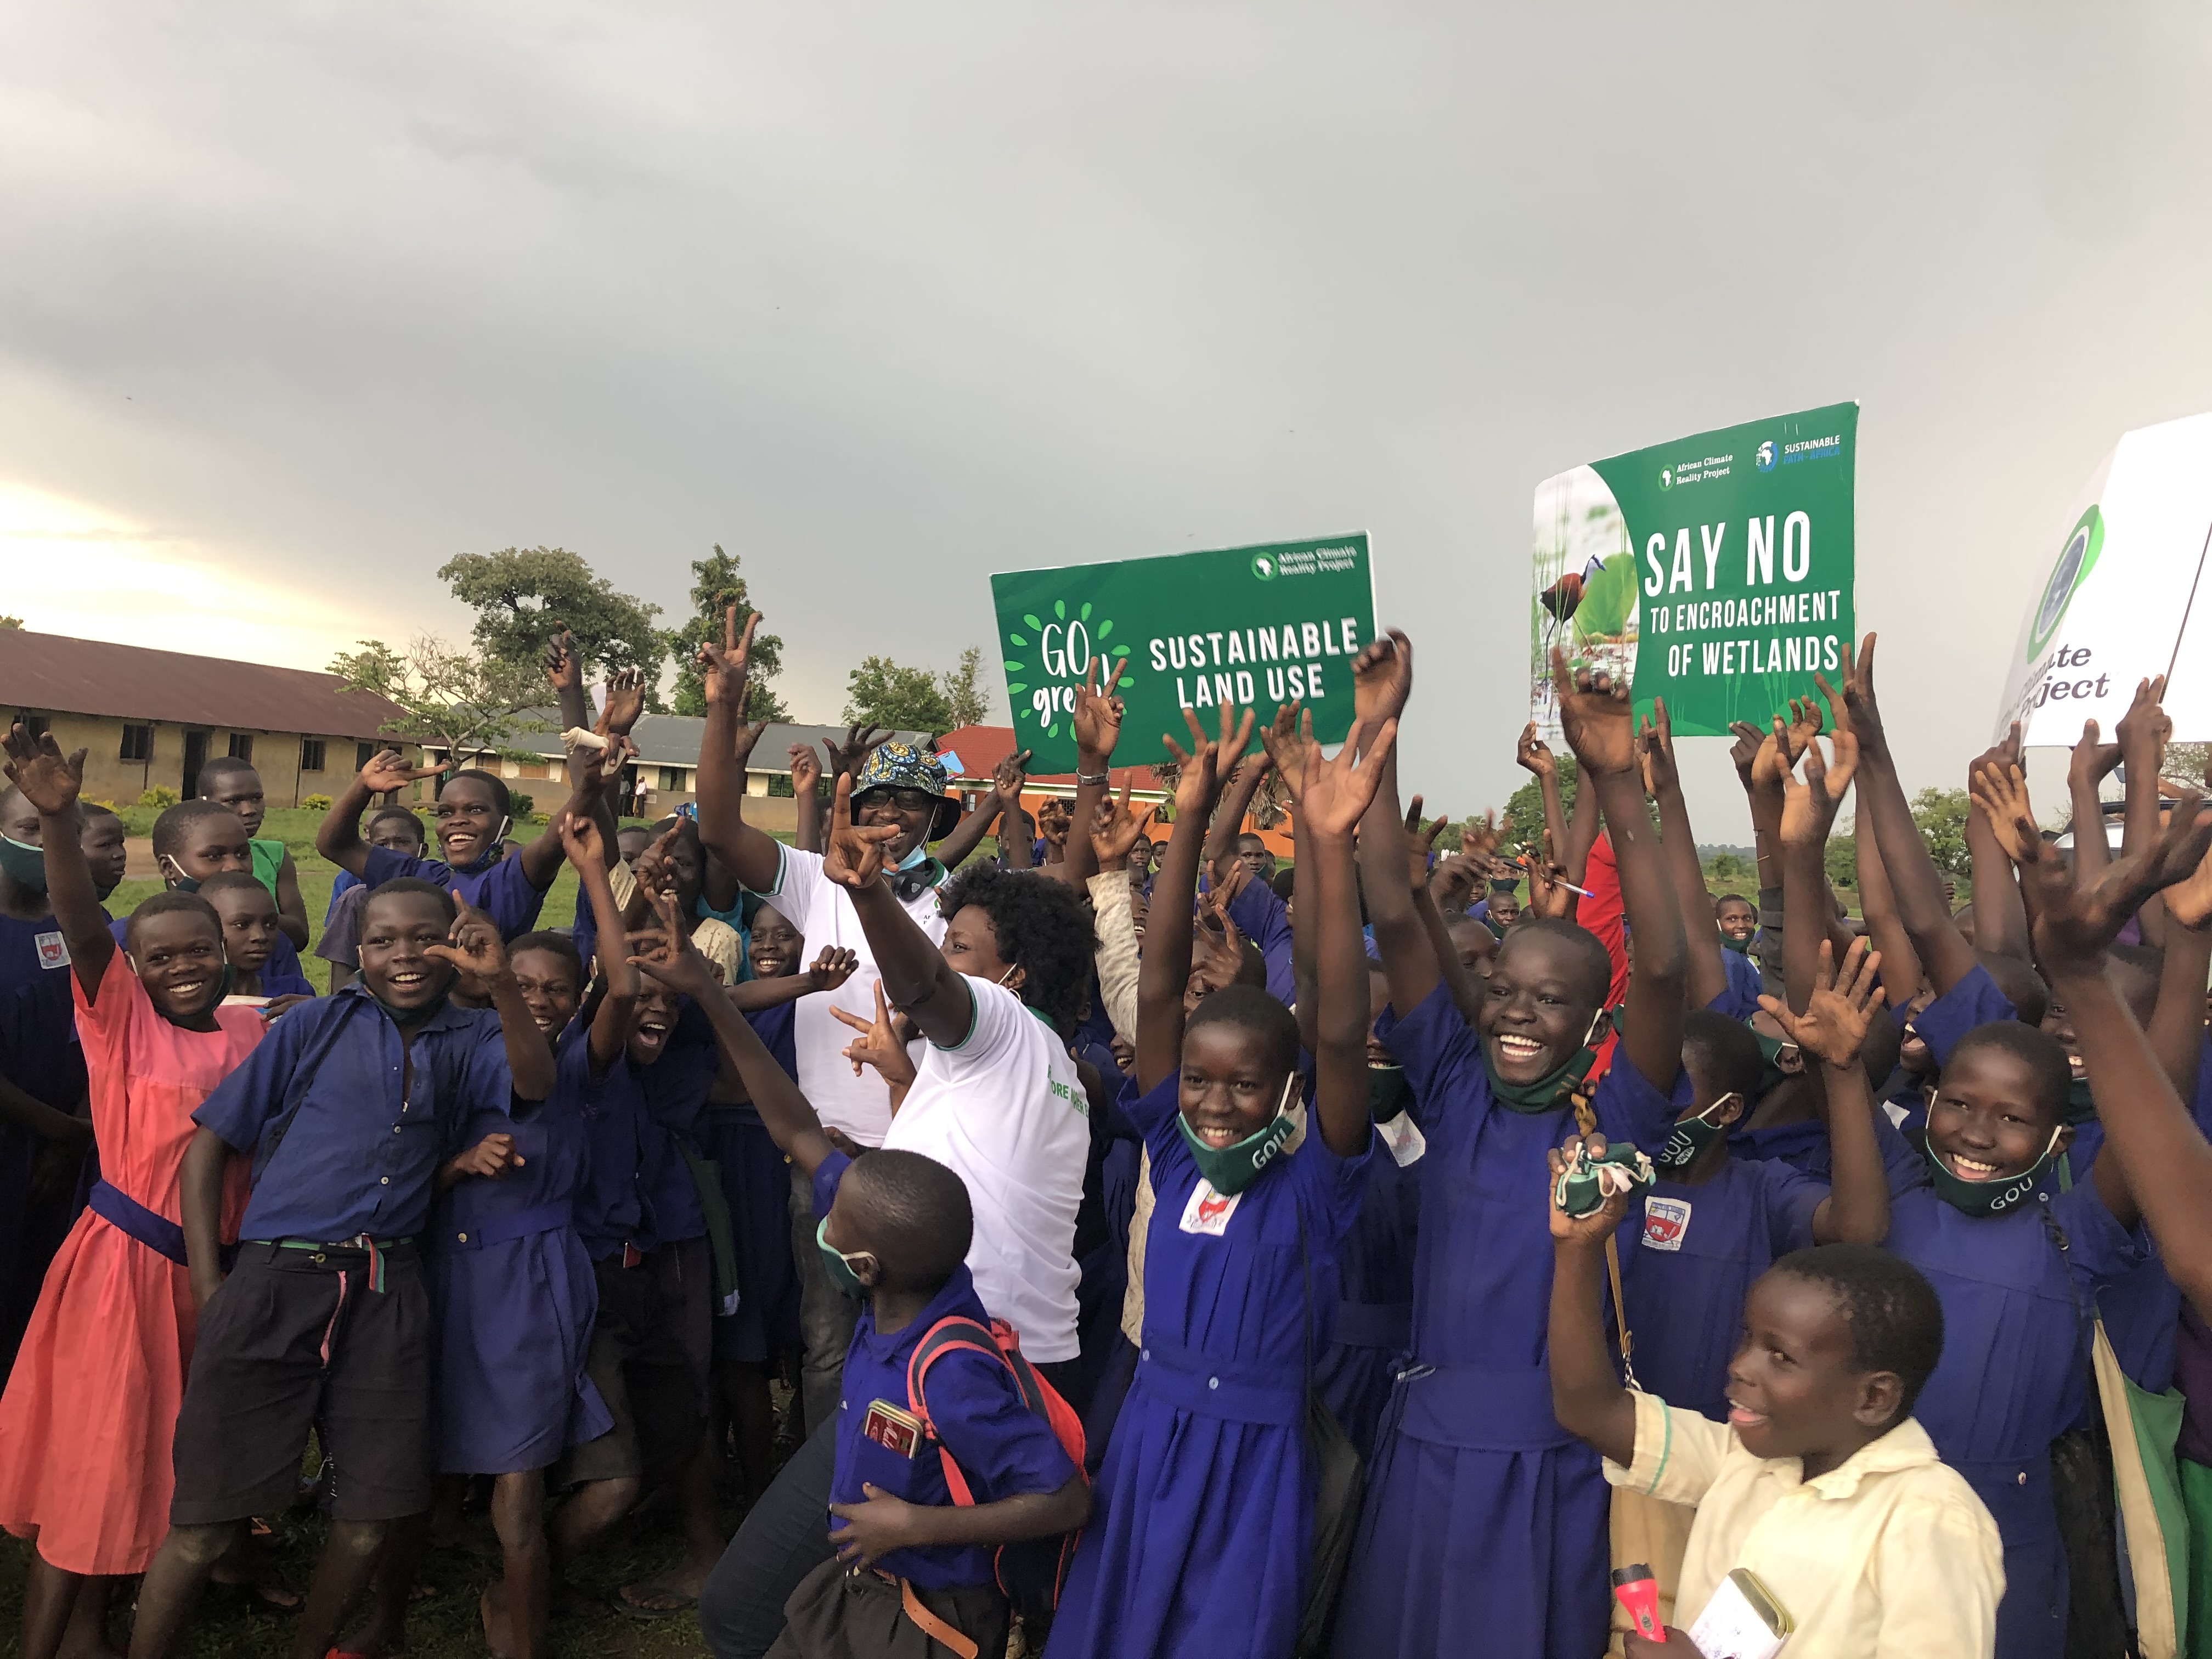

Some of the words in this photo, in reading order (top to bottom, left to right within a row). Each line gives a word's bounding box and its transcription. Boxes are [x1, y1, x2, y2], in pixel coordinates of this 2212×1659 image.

[1676, 460, 1702, 473] African
[1704, 454, 1733, 466] Climate
[1784, 435, 1840, 454] SUSTAINABLE
[1810, 446, 1841, 460] AFRICA
[1676, 471, 1702, 486] Reality
[1703, 466, 1730, 479] Project
[1644, 522, 1726, 597] SAY
[1746, 511, 1810, 586] NO
[1650, 606, 1669, 634] TO
[1676, 590, 1841, 631] ENCROACHMENT
[1042, 620, 1090, 678] GO
[1149, 617, 1359, 672] SUSTAINABLE
[1668, 644, 1693, 677] OF
[1702, 635, 1839, 676] WETLANDS
[1176, 669, 1255, 709] LAND
[1267, 663, 1325, 702] USE
[1990, 1177, 2033, 1210] GOU
